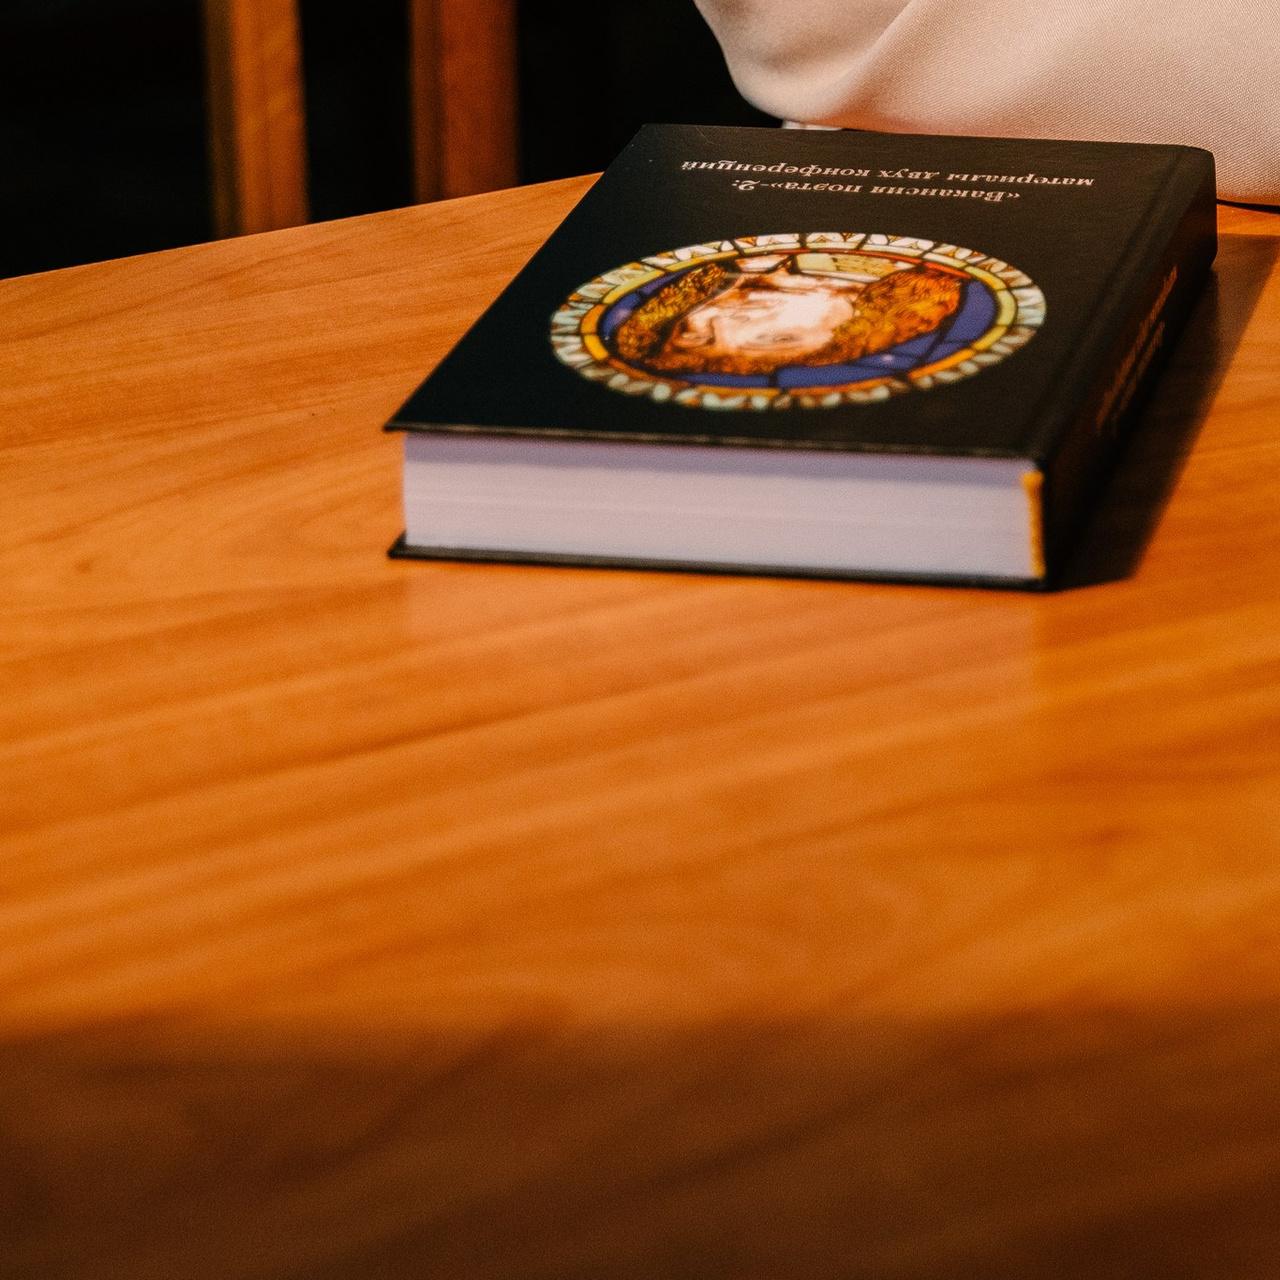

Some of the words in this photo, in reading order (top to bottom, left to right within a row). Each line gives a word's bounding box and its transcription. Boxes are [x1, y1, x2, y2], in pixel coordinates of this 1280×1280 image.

[681, 158, 871, 178] конференций
[877, 168, 940, 182] двух
[946, 172, 1095, 187] материалы
[871, 182, 1021, 202] «Вакансия
